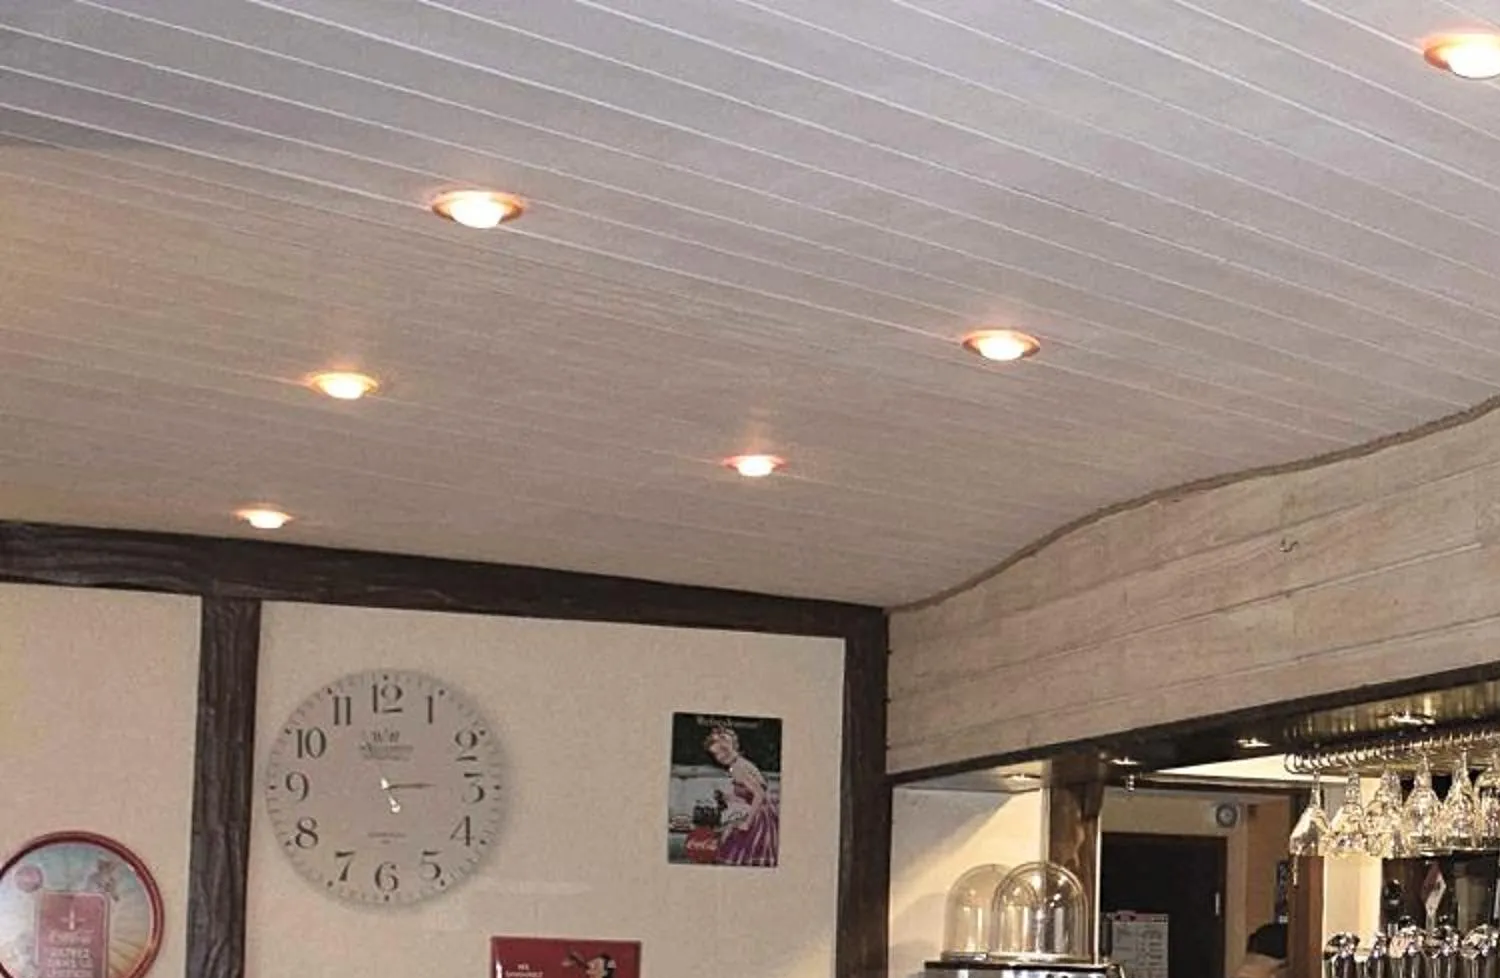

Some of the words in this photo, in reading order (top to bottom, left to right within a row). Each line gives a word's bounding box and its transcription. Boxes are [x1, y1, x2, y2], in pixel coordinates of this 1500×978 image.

[333, 695, 352, 726] 11
[372, 683, 403, 714] 12
[426, 694, 434, 725] 1
[296, 727, 327, 760] 10
[455, 728, 478, 763] 2
[285, 771, 310, 803] 9
[461, 772, 485, 804] 3
[294, 816, 319, 849] 8
[450, 815, 476, 847] 4
[335, 850, 356, 882] 7
[374, 861, 399, 893] 6
[419, 850, 442, 881] 5
